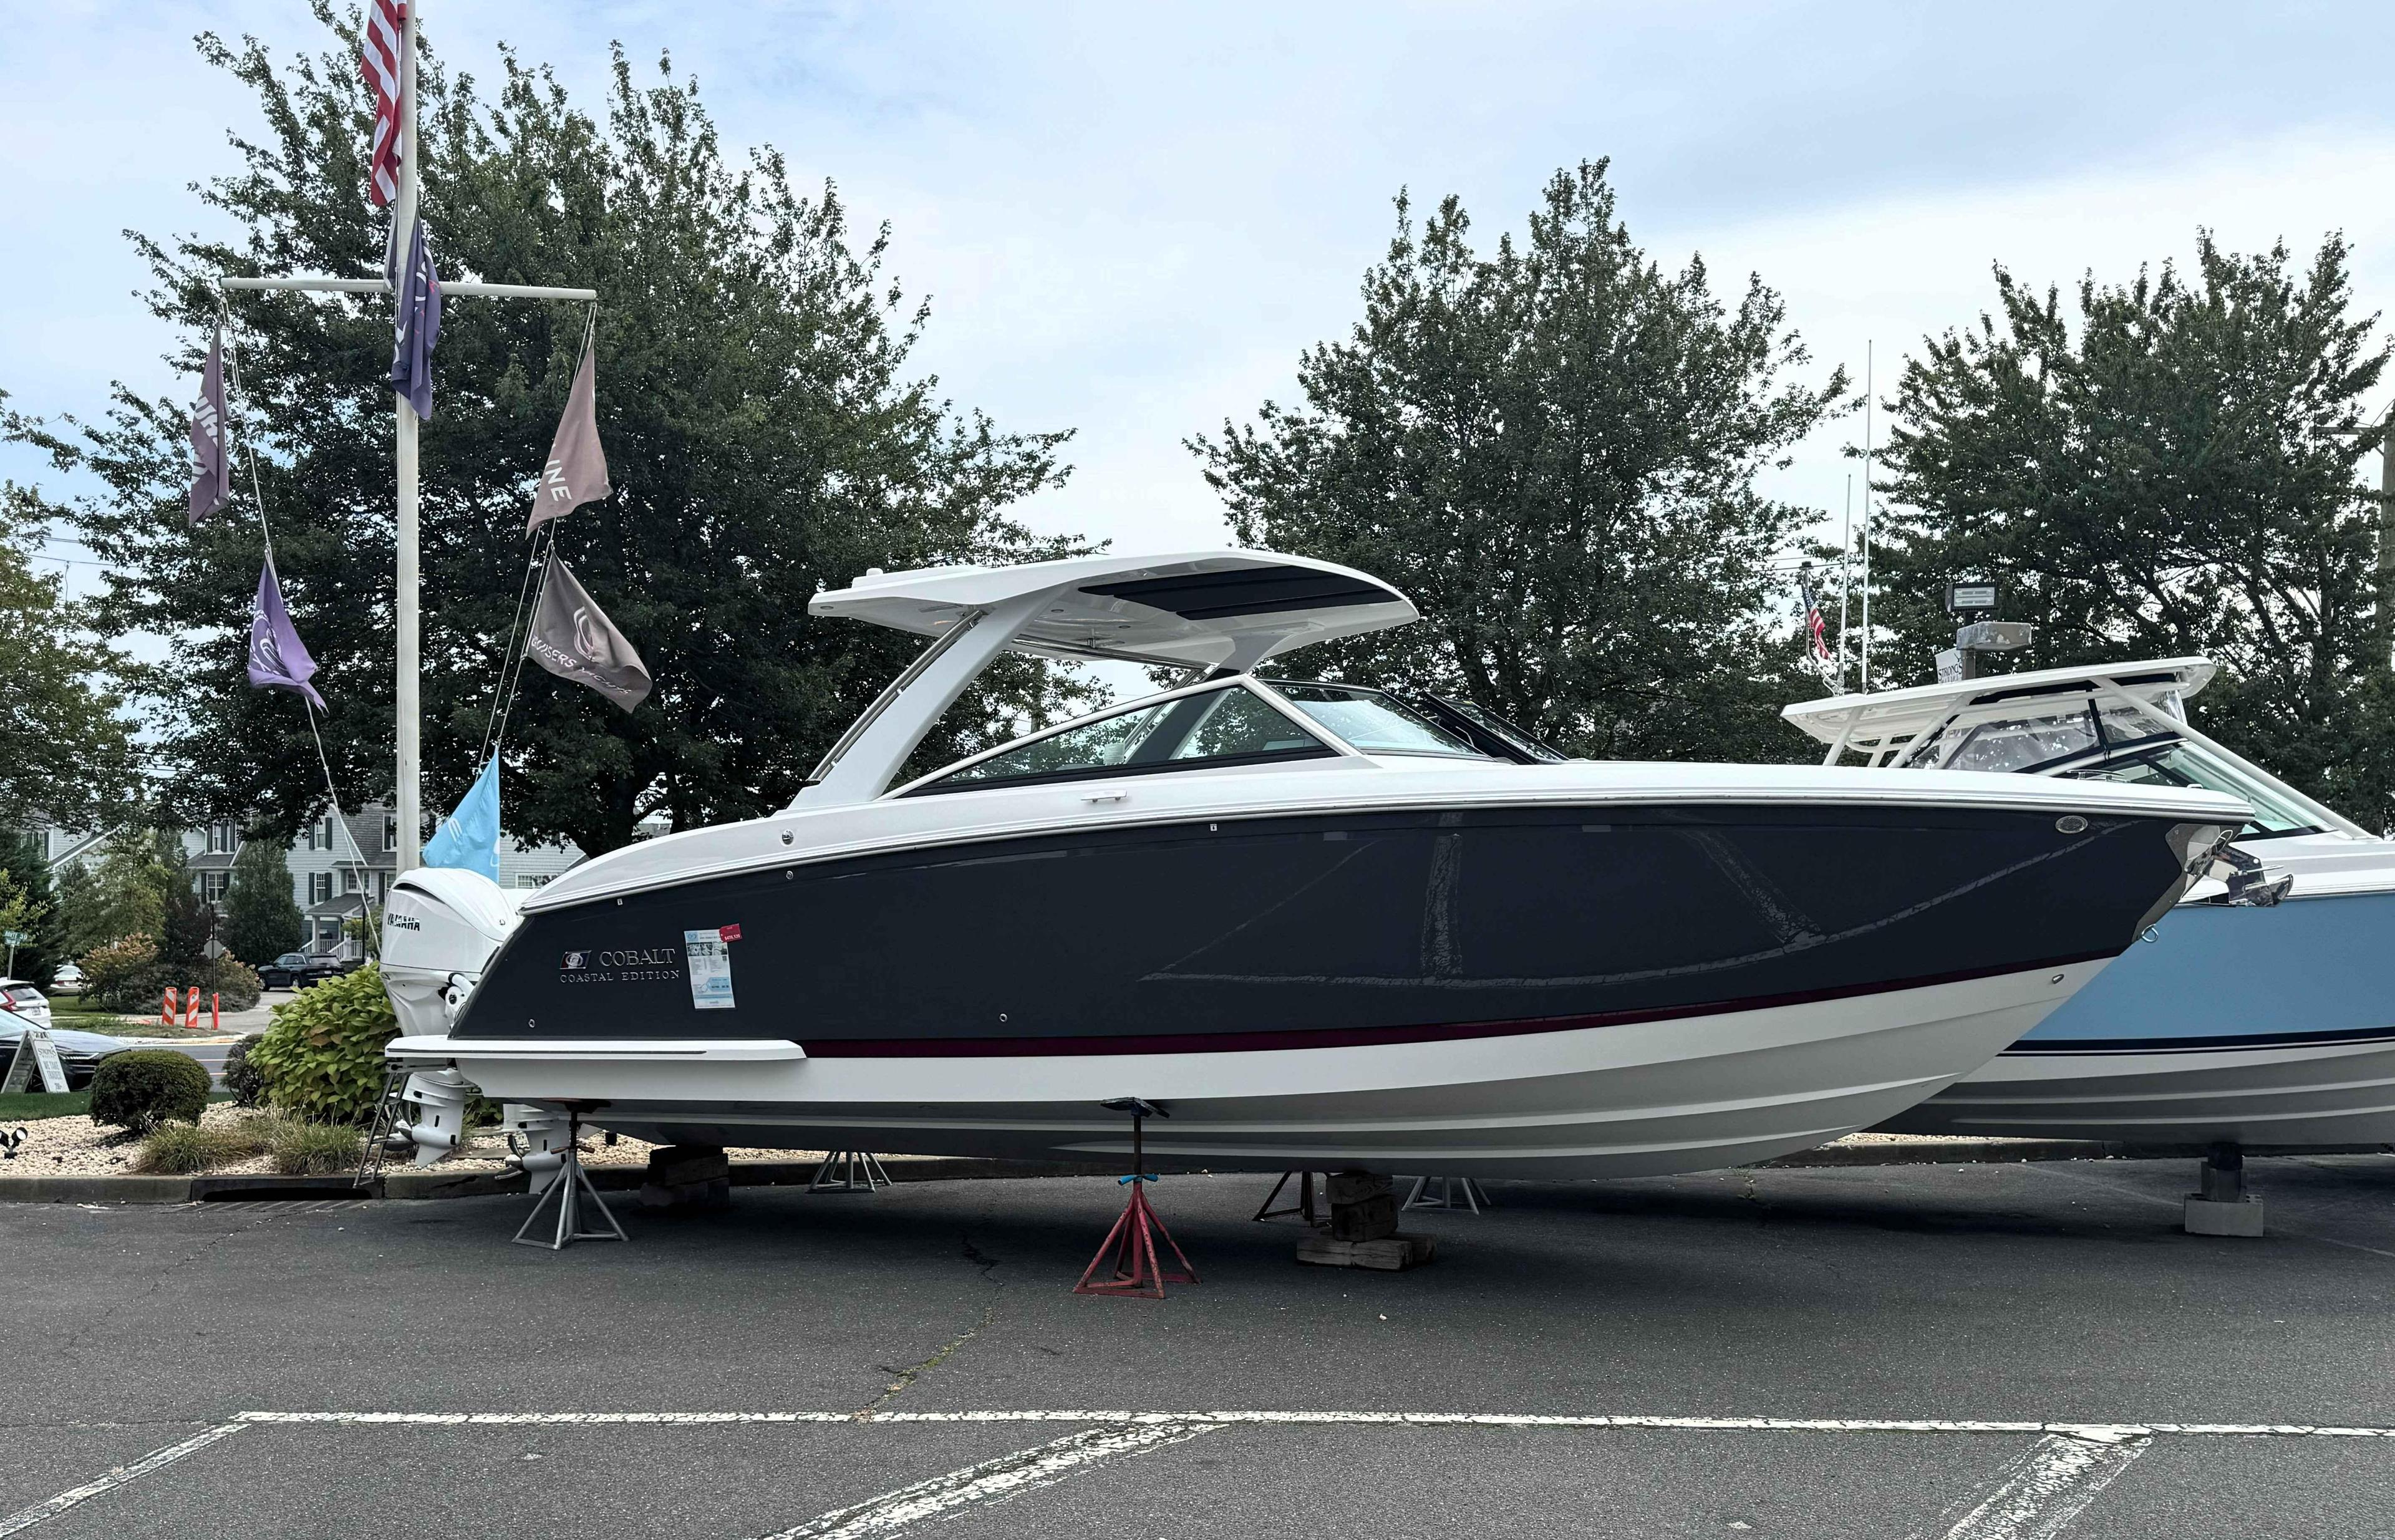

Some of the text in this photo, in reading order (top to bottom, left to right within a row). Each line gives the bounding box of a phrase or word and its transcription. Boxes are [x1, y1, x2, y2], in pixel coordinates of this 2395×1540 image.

[387, 913, 420, 931] YAMAHA
[599, 949, 676, 966] COBALT
[560, 970, 680, 983] COASTAL EDITION
